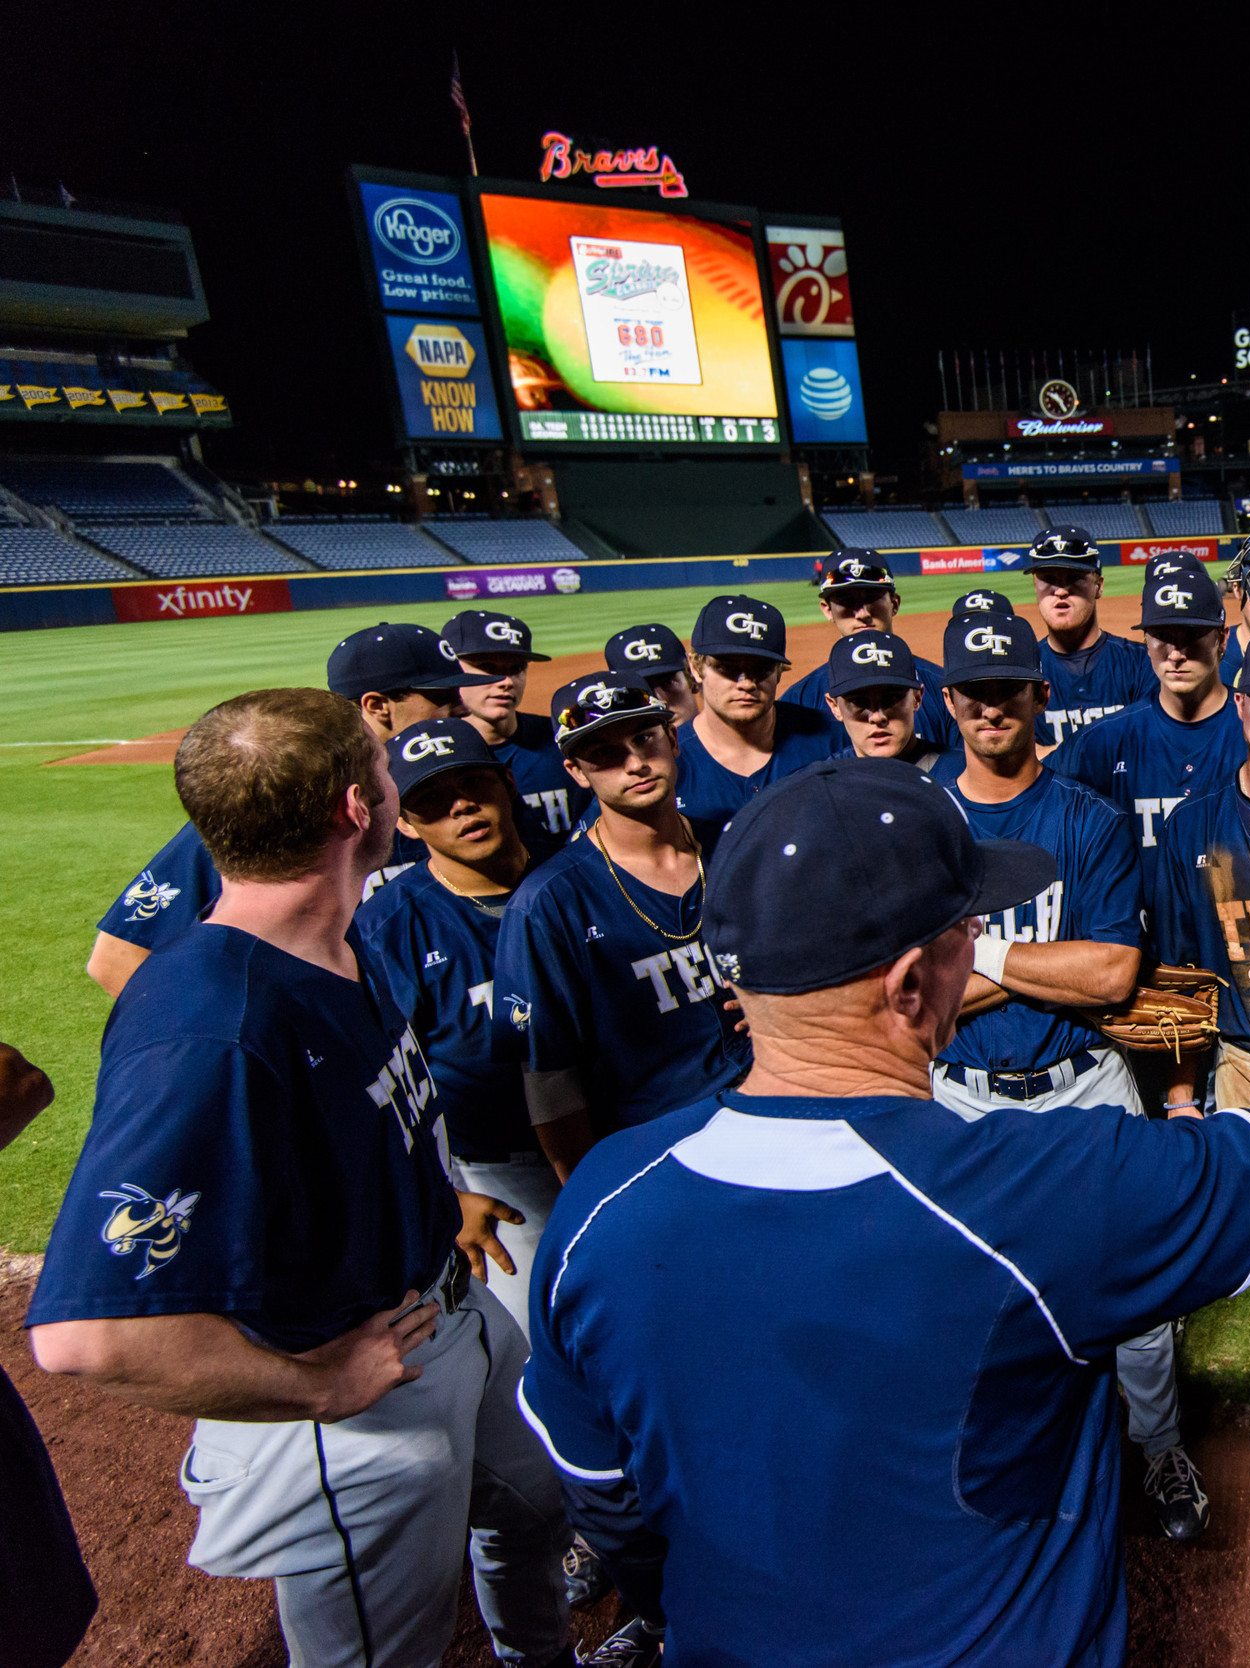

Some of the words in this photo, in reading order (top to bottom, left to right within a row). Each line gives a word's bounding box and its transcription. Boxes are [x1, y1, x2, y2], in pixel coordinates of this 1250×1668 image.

[540, 131, 659, 182] Braves
[385, 209, 451, 256] Kroger
[382, 269, 428, 285] Great
[432, 273, 471, 289] food.
[383, 283, 417, 298] Low
[421, 289, 476, 303] prices.
[618, 324, 664, 347] 680
[418, 339, 467, 365] NAPA
[420, 380, 476, 408] KNOW
[431, 407, 474, 432] HOW
[1017, 420, 1104, 436] Budweiser
[762, 425, 776, 442] 3
[1008, 465, 1043, 476] HERE'S
[1044, 465, 1057, 474] TO
[1058, 464, 1095, 474] BRAVES
[1097, 462, 1143, 473] COUNTRY
[922, 558, 946, 569] Bank
[947, 558, 957, 568] of
[958, 557, 996, 567] America
[157, 586, 252, 614] xfinity
[965, 593, 994, 610] GT
[1154, 584, 1193, 609] GT
[485, 621, 523, 645] GT
[726, 612, 768, 640] GT
[624, 639, 661, 661] GT
[964, 626, 1012, 655] GT
[852, 642, 893, 667] GT
[402, 732, 454, 762] GT
